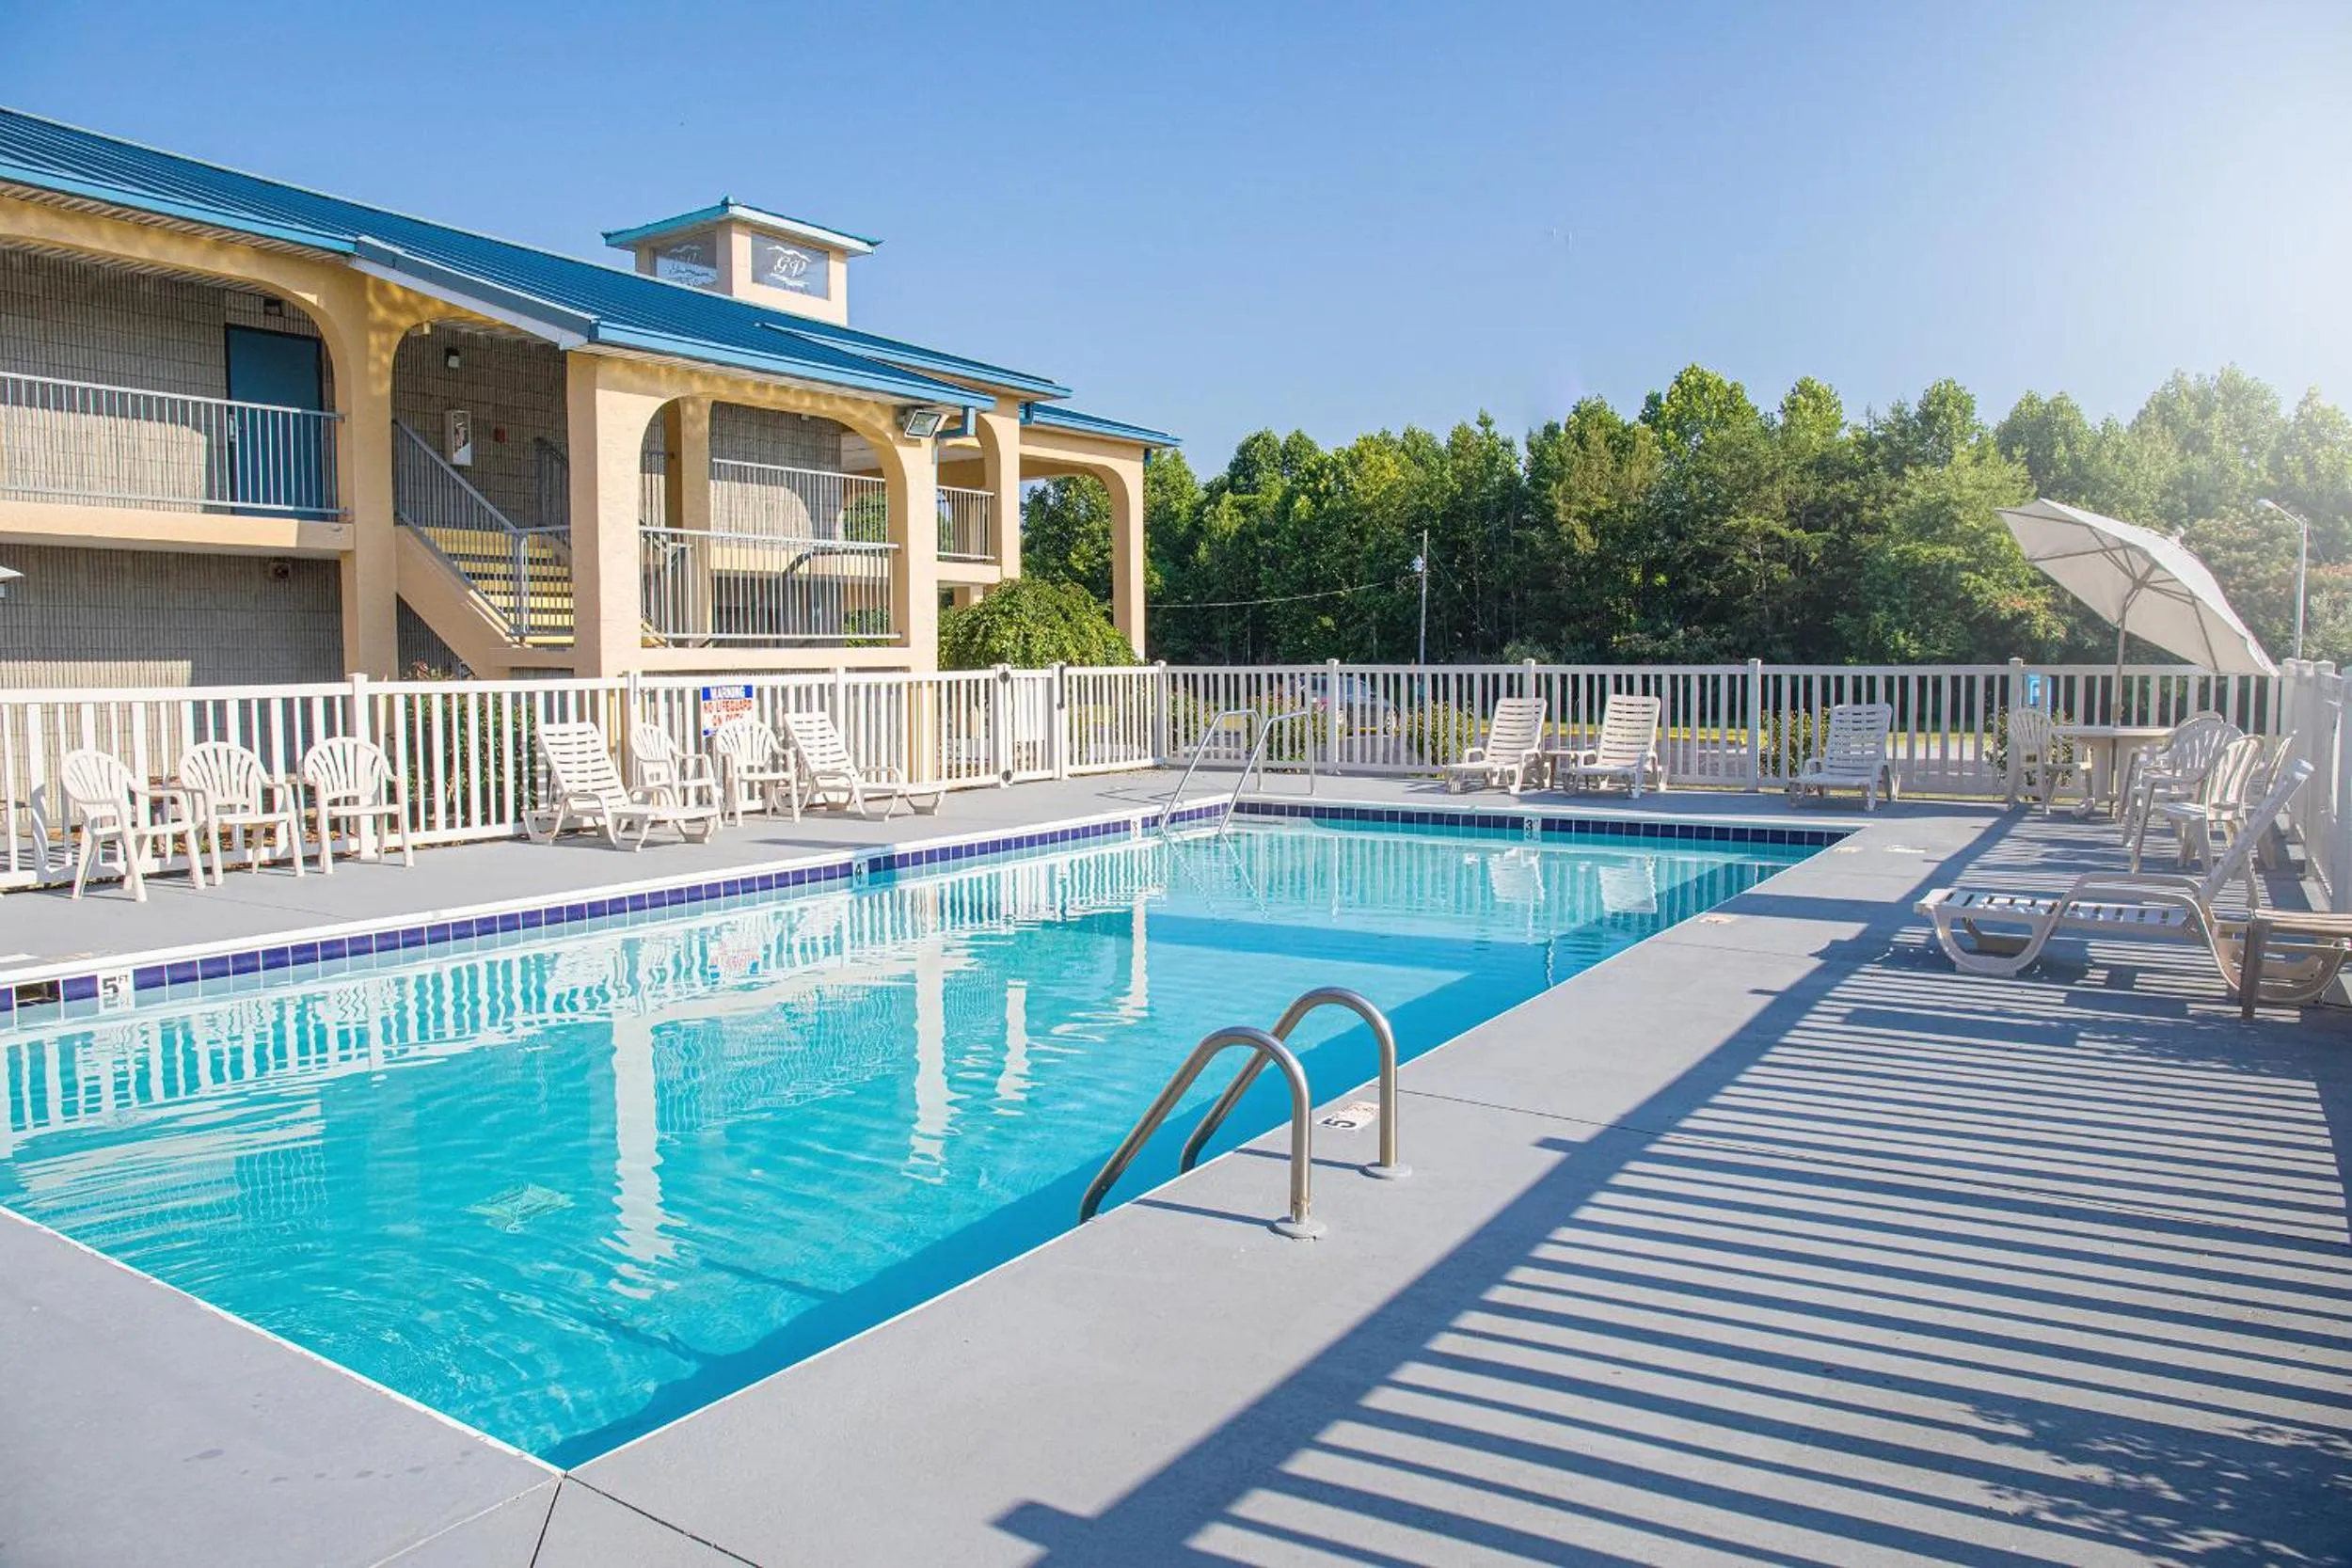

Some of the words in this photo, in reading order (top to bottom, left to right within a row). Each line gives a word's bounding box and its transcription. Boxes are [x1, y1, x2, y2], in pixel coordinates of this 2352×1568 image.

[704, 702, 713, 713] NO
[717, 699, 753, 712] LIFEGUARD
[712, 715, 723, 726] ON
[1526, 819, 1534, 831] 3
[103, 976, 119, 993] 5
[1321, 1117, 1357, 1129] 5
